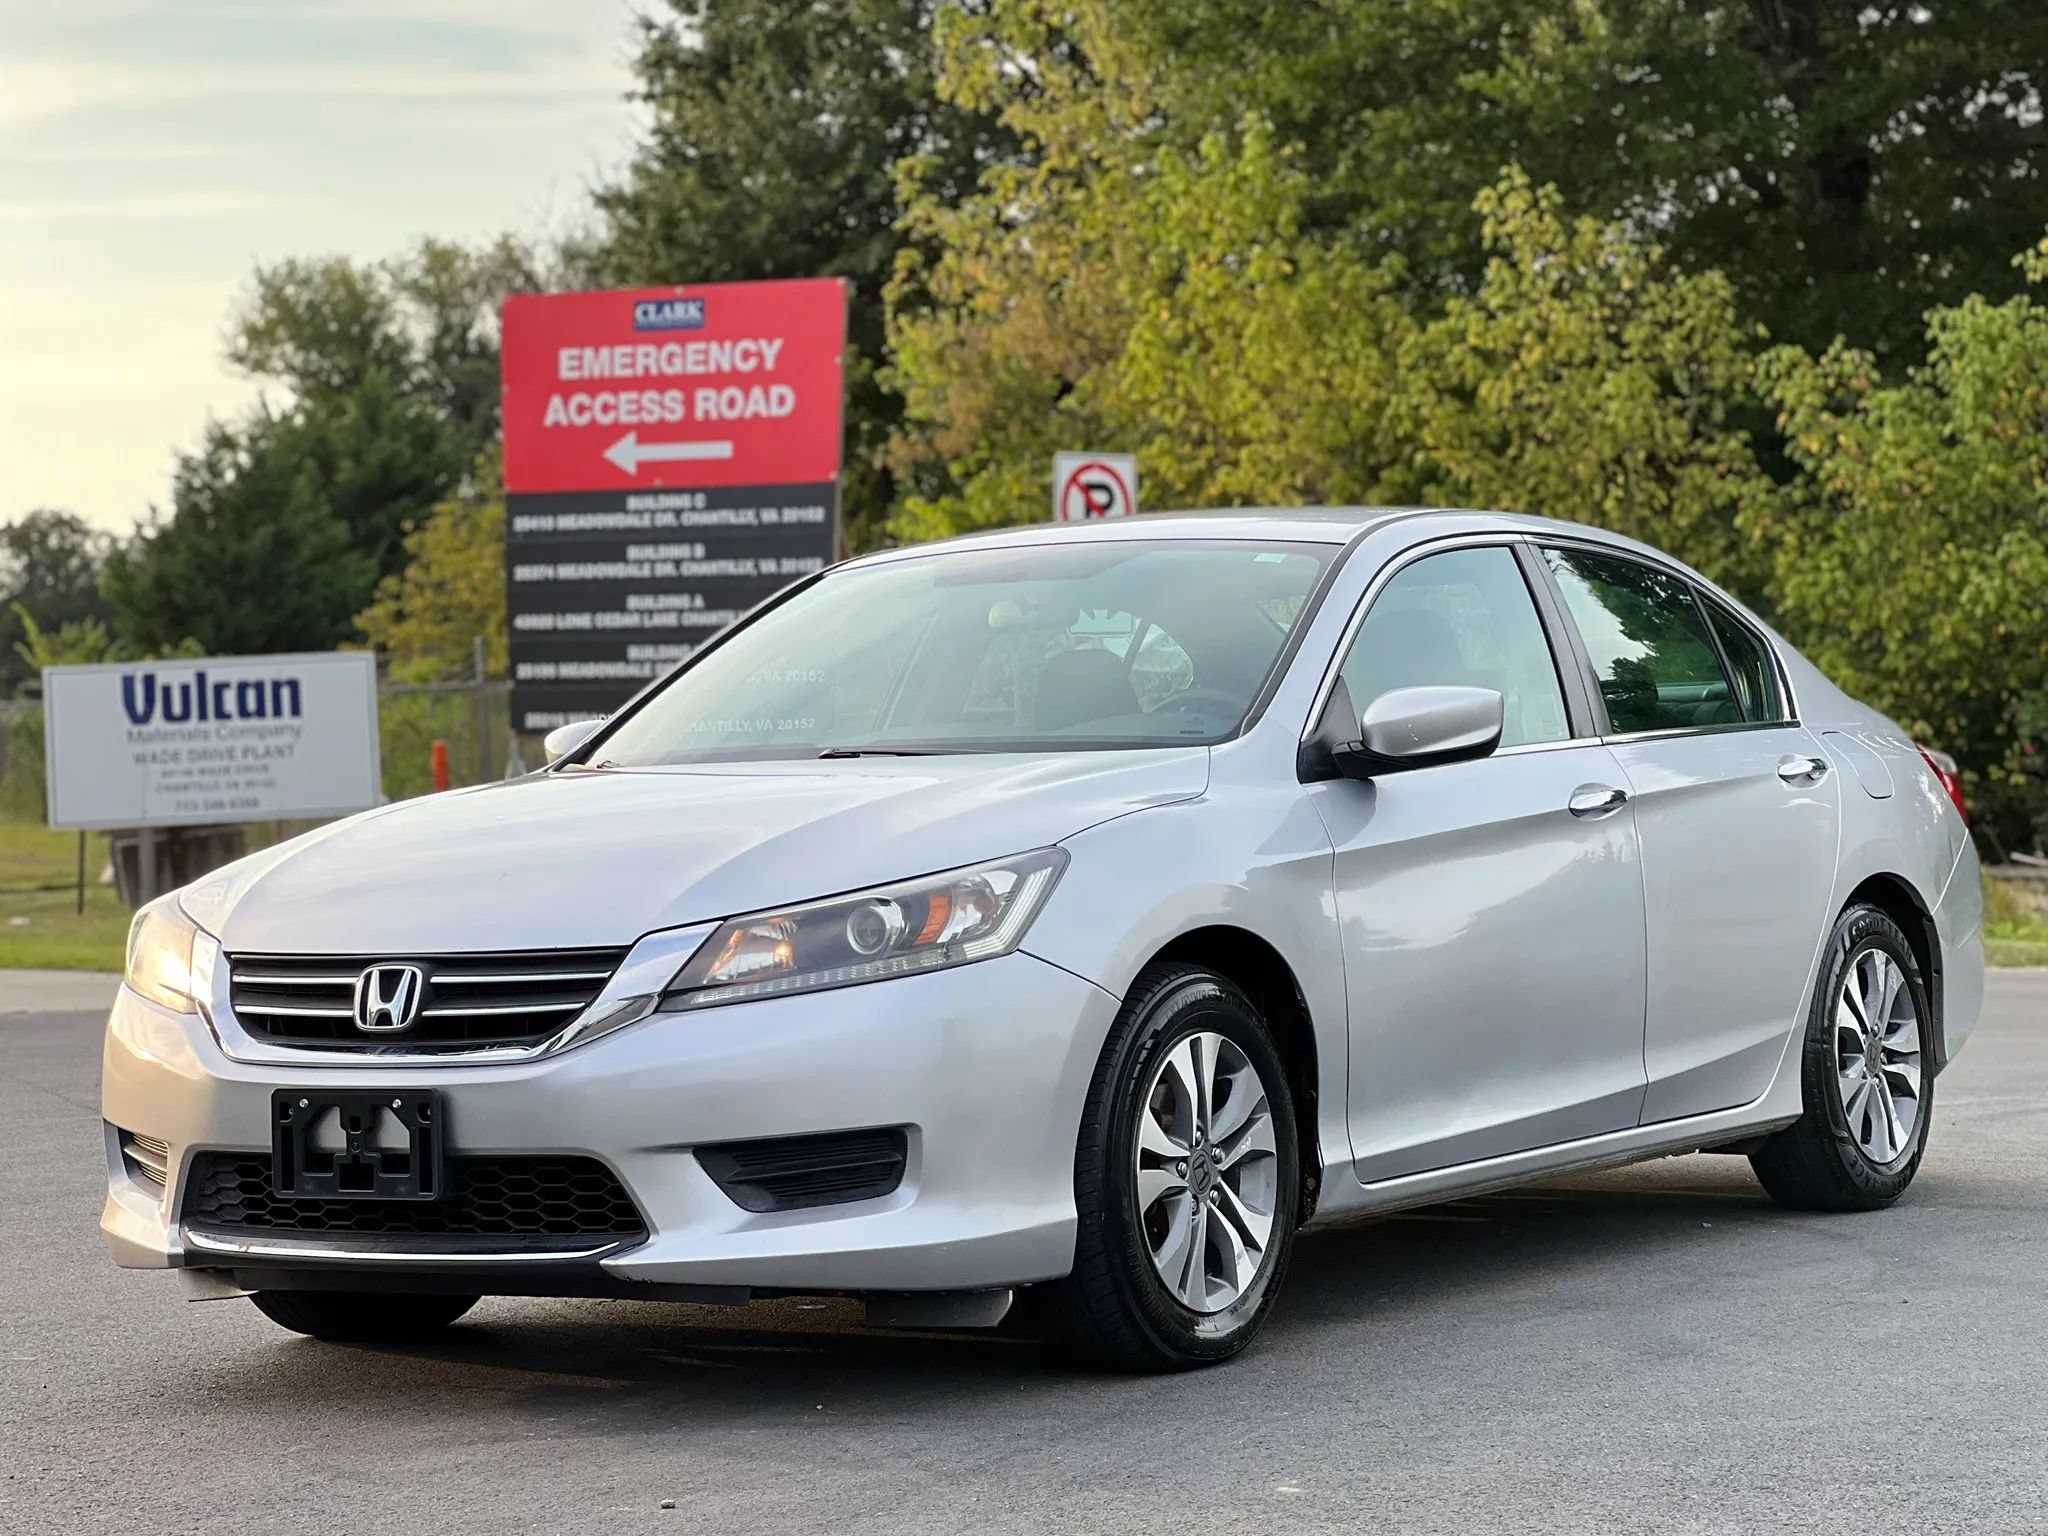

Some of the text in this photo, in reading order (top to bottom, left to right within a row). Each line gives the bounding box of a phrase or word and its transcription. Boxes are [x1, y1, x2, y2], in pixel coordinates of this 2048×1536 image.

[634, 301, 704, 323] CLARK
[558, 338, 784, 380] EMERGENCY
[543, 384, 797, 427] ACCESS ROAD
[626, 493, 692, 511] BUILDING
[556, 511, 650, 530] MEADOWDALE
[626, 543, 692, 561] BUILDING
[556, 561, 650, 580] MEADOWDALE
[626, 593, 692, 611] BUILDING
[121, 671, 301, 726] Vulcan
[126, 723, 303, 744] Materials Company
[756, 719, 774, 731] VA
[777, 718, 816, 731] 20152
[241, 743, 295, 760] PLANT
